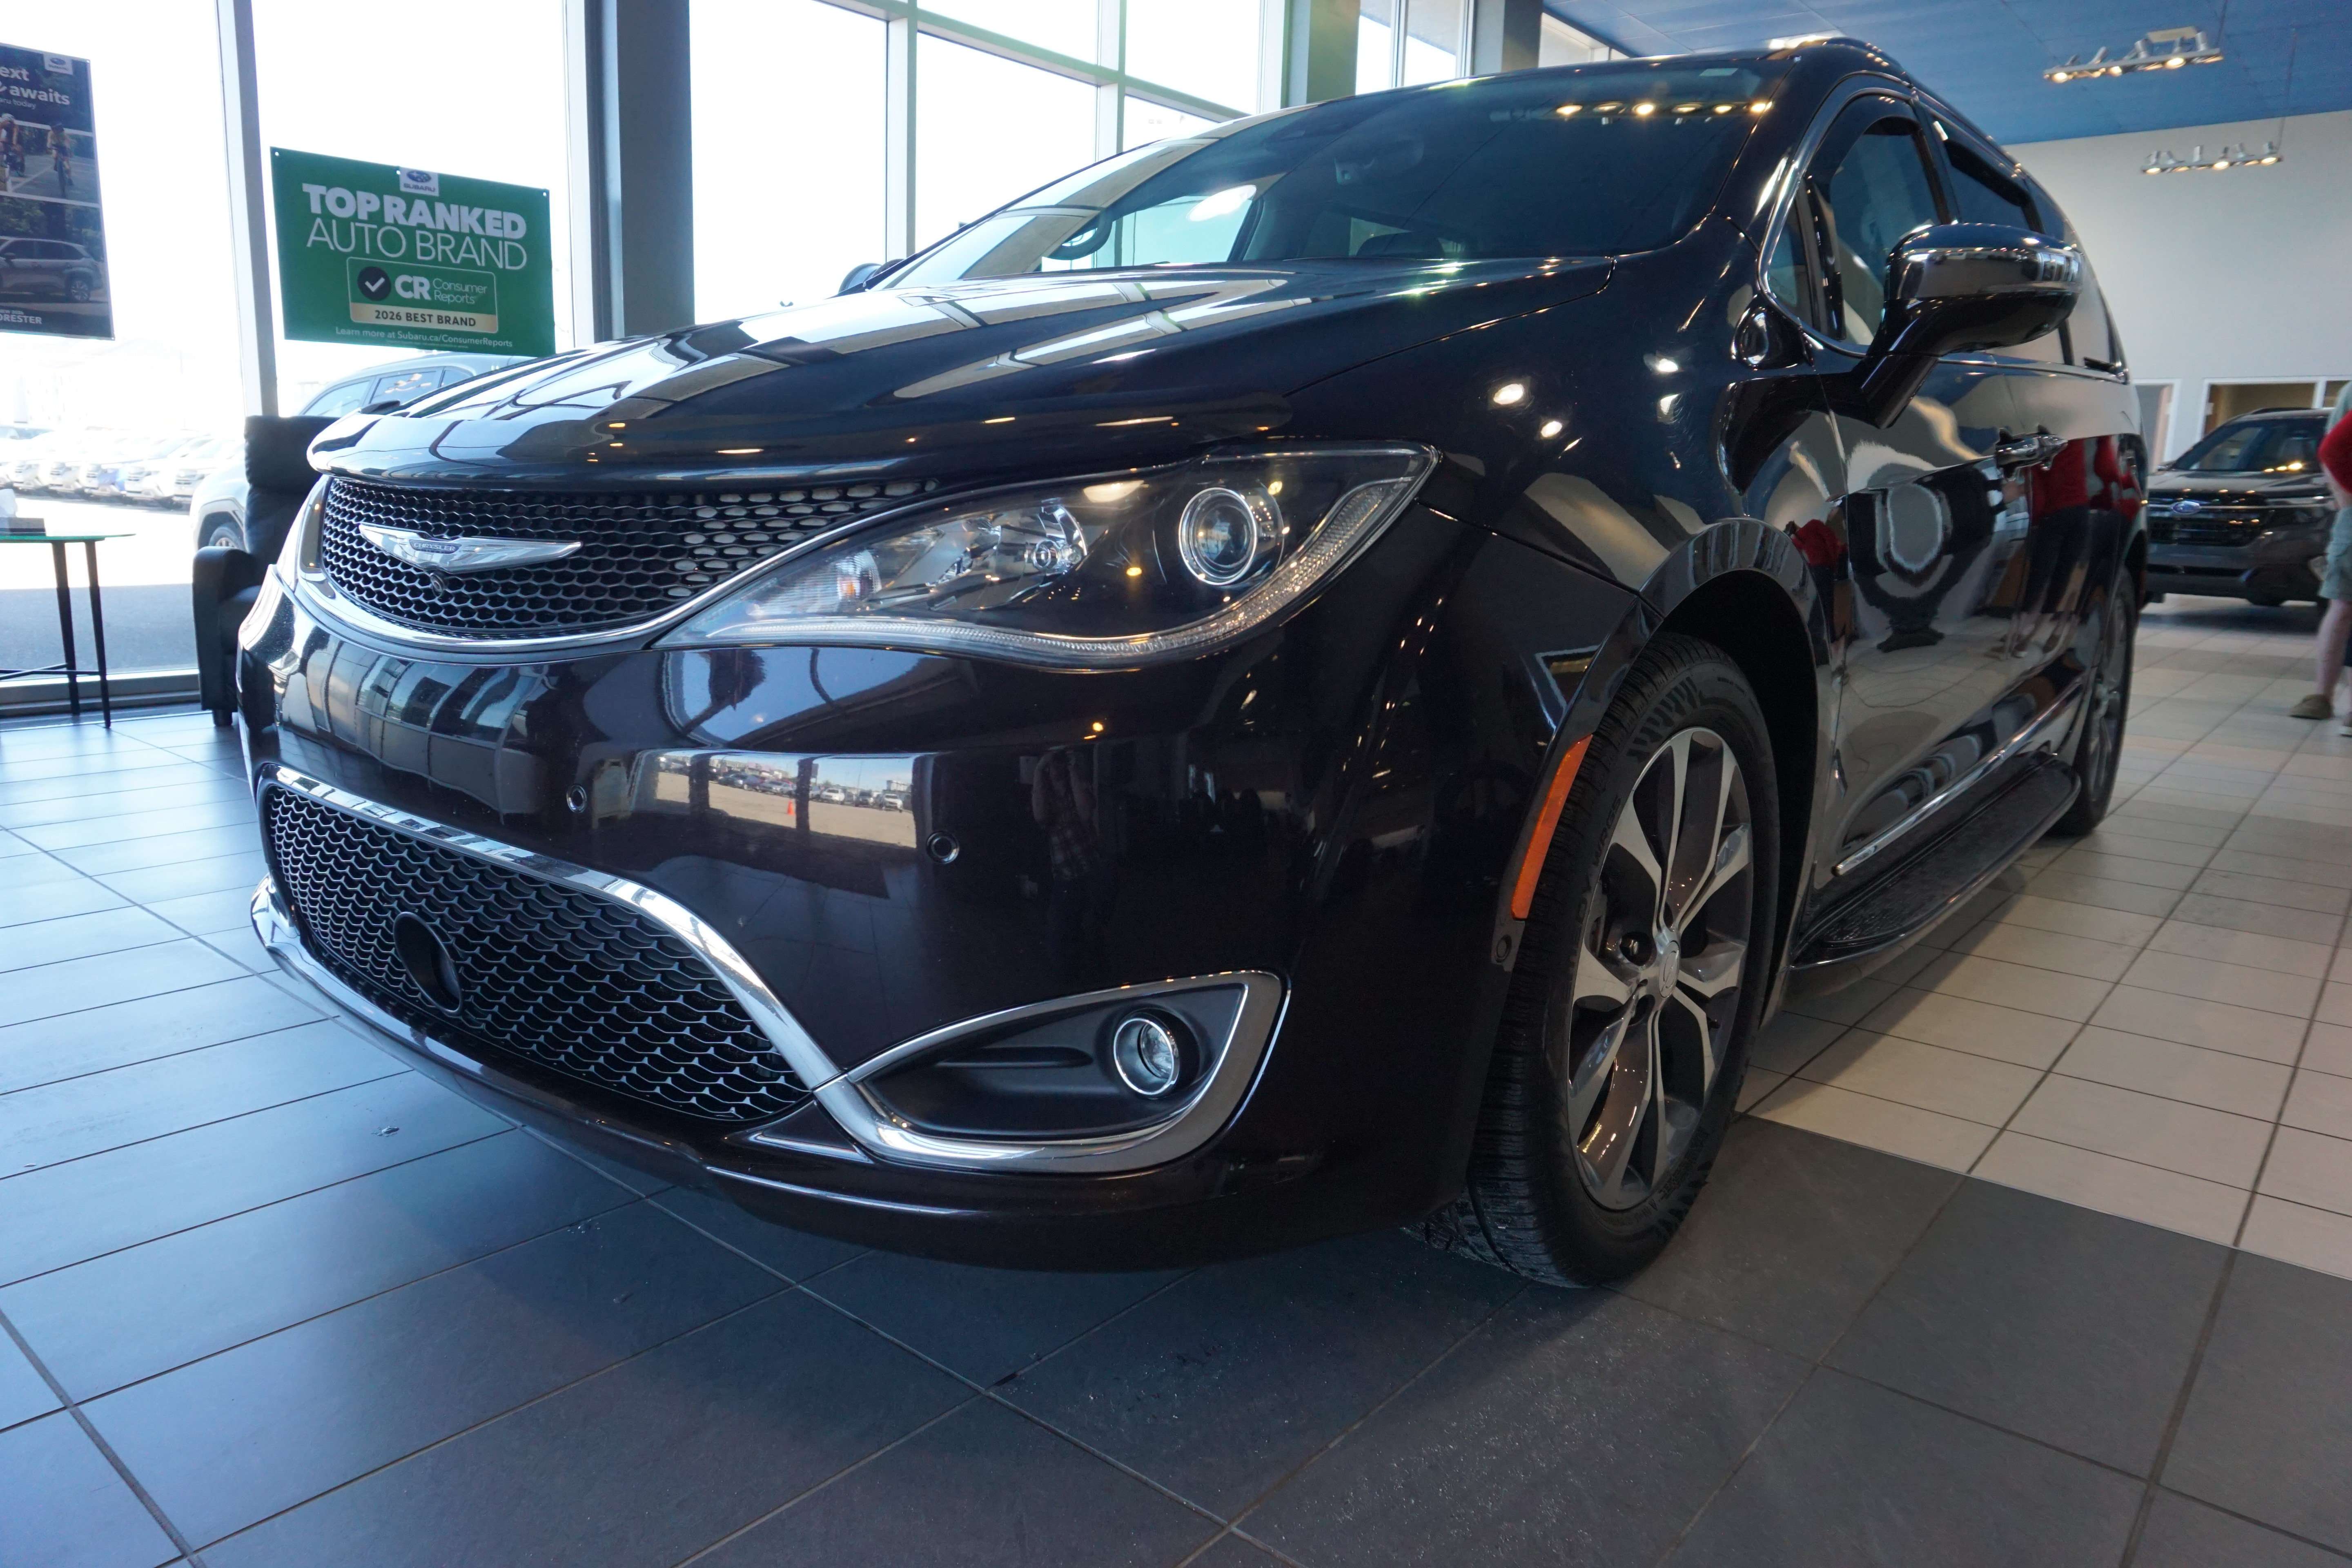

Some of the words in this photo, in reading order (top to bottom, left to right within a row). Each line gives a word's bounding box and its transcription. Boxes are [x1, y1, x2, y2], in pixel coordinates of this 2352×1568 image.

[9, 85, 70, 105] awaits
[403, 183, 436, 192] SUBARU
[302, 183, 380, 220] TOP
[383, 194, 527, 239] RANKED
[306, 217, 406, 257] AUTO
[416, 229, 527, 270] BRAND
[395, 274, 432, 300] CR
[432, 278, 488, 294] Consumer
[434, 290, 475, 304] Reports
[375, 310, 402, 321] 2026
[405, 312, 434, 323] BEST
[437, 315, 477, 327] BRAND
[336, 327, 360, 336] Learn
[362, 330, 385, 339] more
[397, 331, 513, 347] Subaru.ca/ConsumerReports
[414, 542, 456, 551] CHRYSLER
